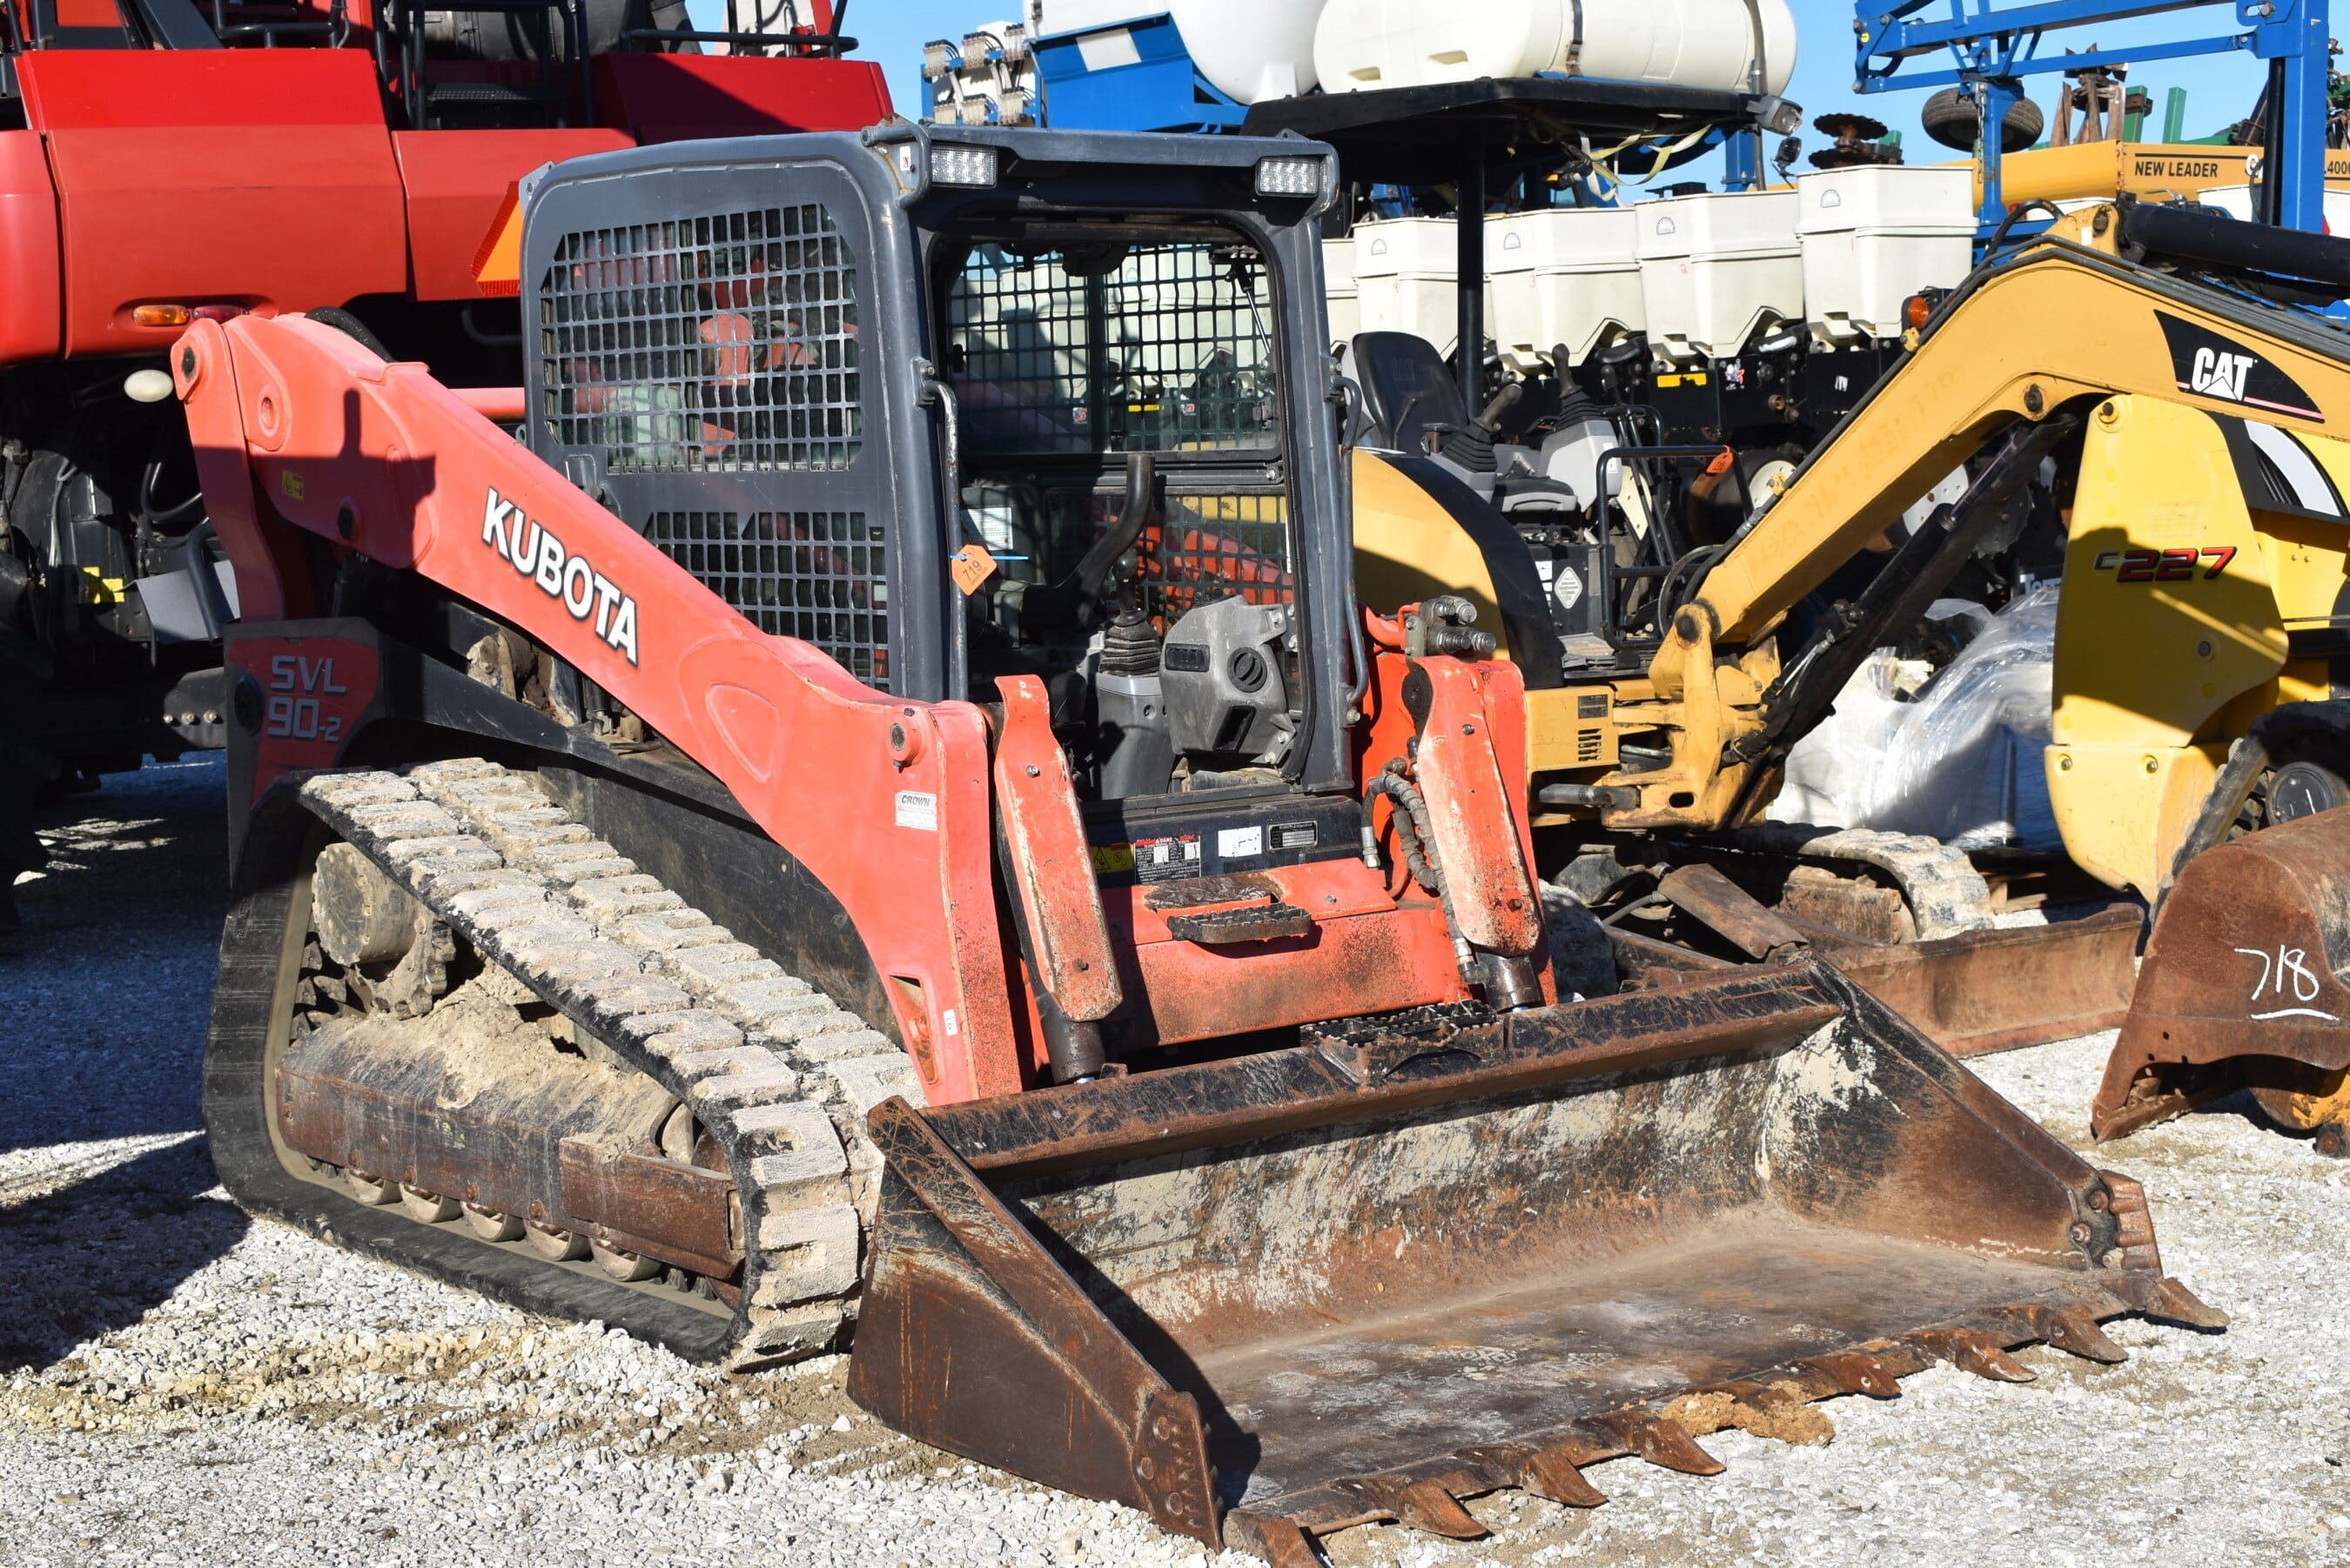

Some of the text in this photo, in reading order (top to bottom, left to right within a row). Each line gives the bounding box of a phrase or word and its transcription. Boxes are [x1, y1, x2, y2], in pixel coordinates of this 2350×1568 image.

[2134, 161, 2219, 178] NEW LEADER
[2192, 347, 2254, 402] CAT
[482, 485, 638, 667] KUBOTA
[962, 560, 982, 582] 719
[2093, 546, 2239, 583] C227
[270, 654, 347, 694] SVL
[266, 696, 342, 741] 90-2
[902, 794, 931, 807] CROWN
[2234, 944, 2320, 1002] 718
